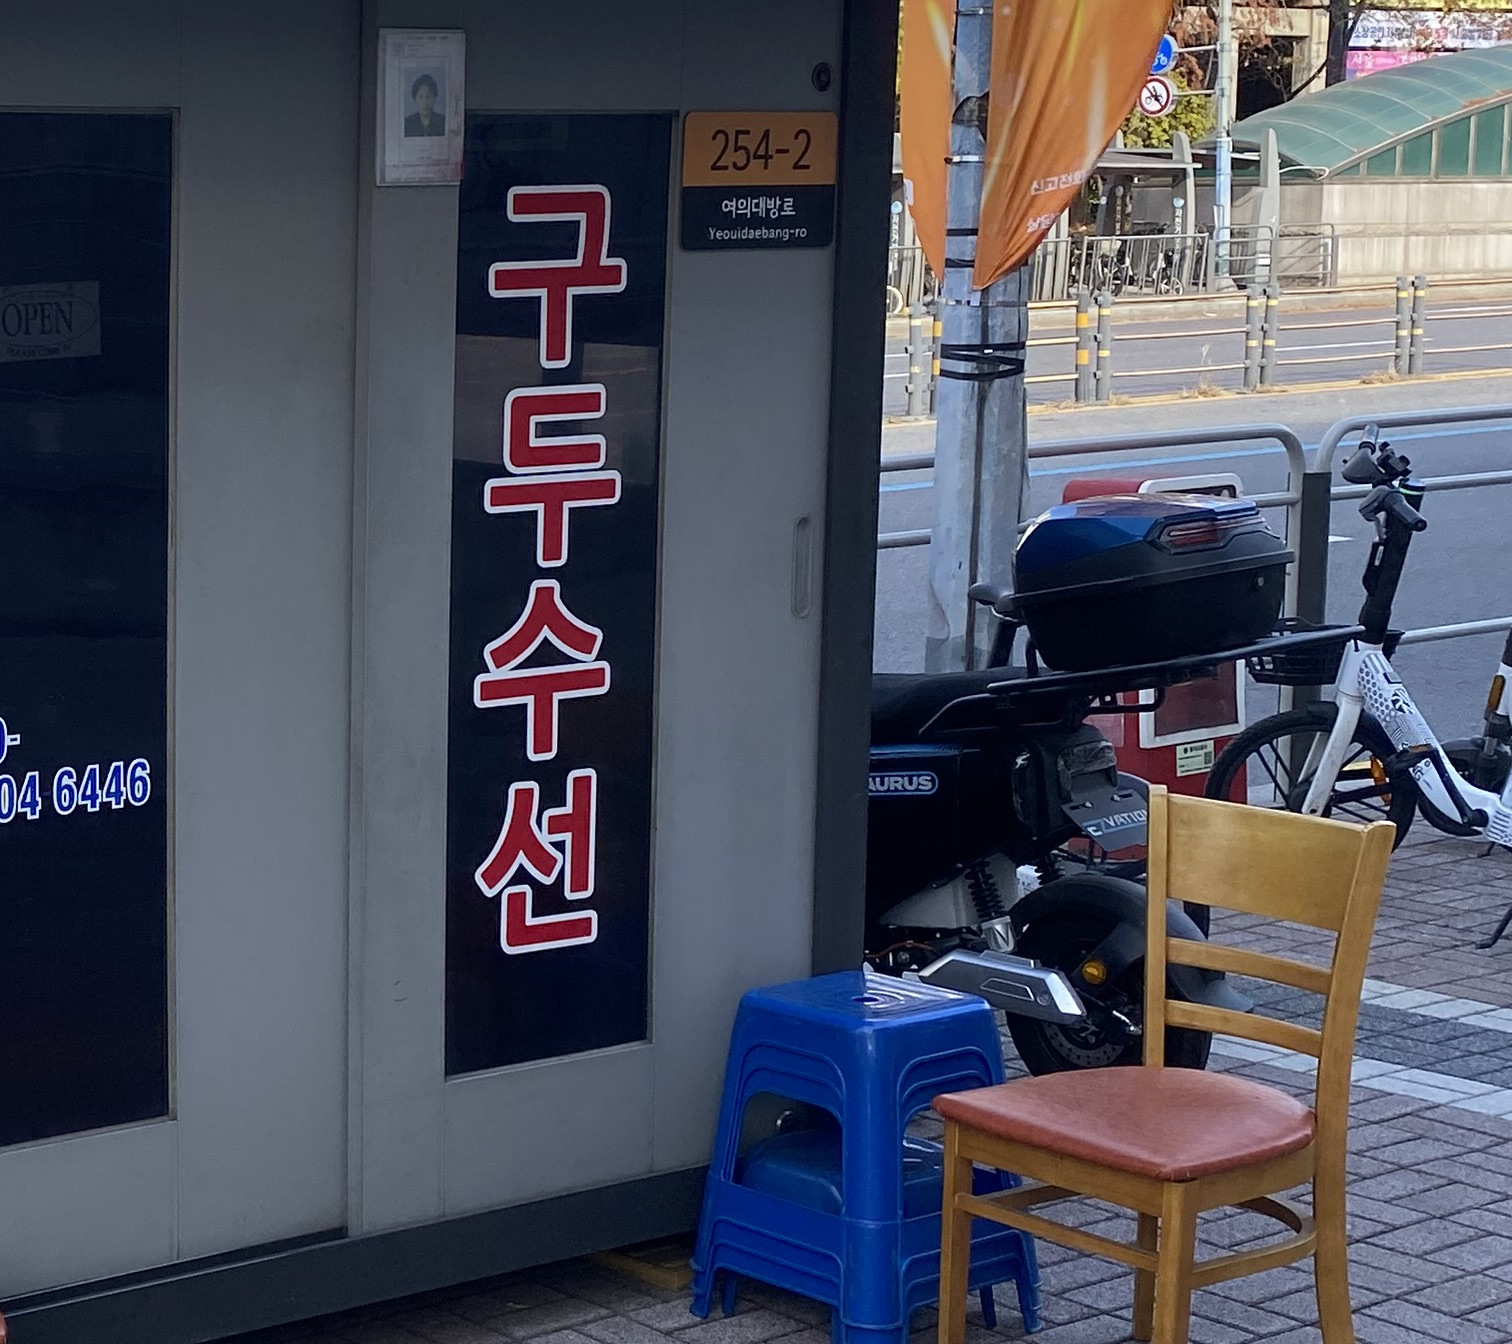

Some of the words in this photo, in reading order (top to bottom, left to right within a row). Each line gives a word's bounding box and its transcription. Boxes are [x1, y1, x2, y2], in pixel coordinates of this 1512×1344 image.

[710, 128, 812, 171] 254-2
[721, 196, 797, 219] 여의대방로
[708, 226, 809, 242] Yeouidaebang-ro
[1, 301, 74, 337] OPEN
[474, 183, 627, 955] 구두수선
[53, 758, 151, 815] 6446
